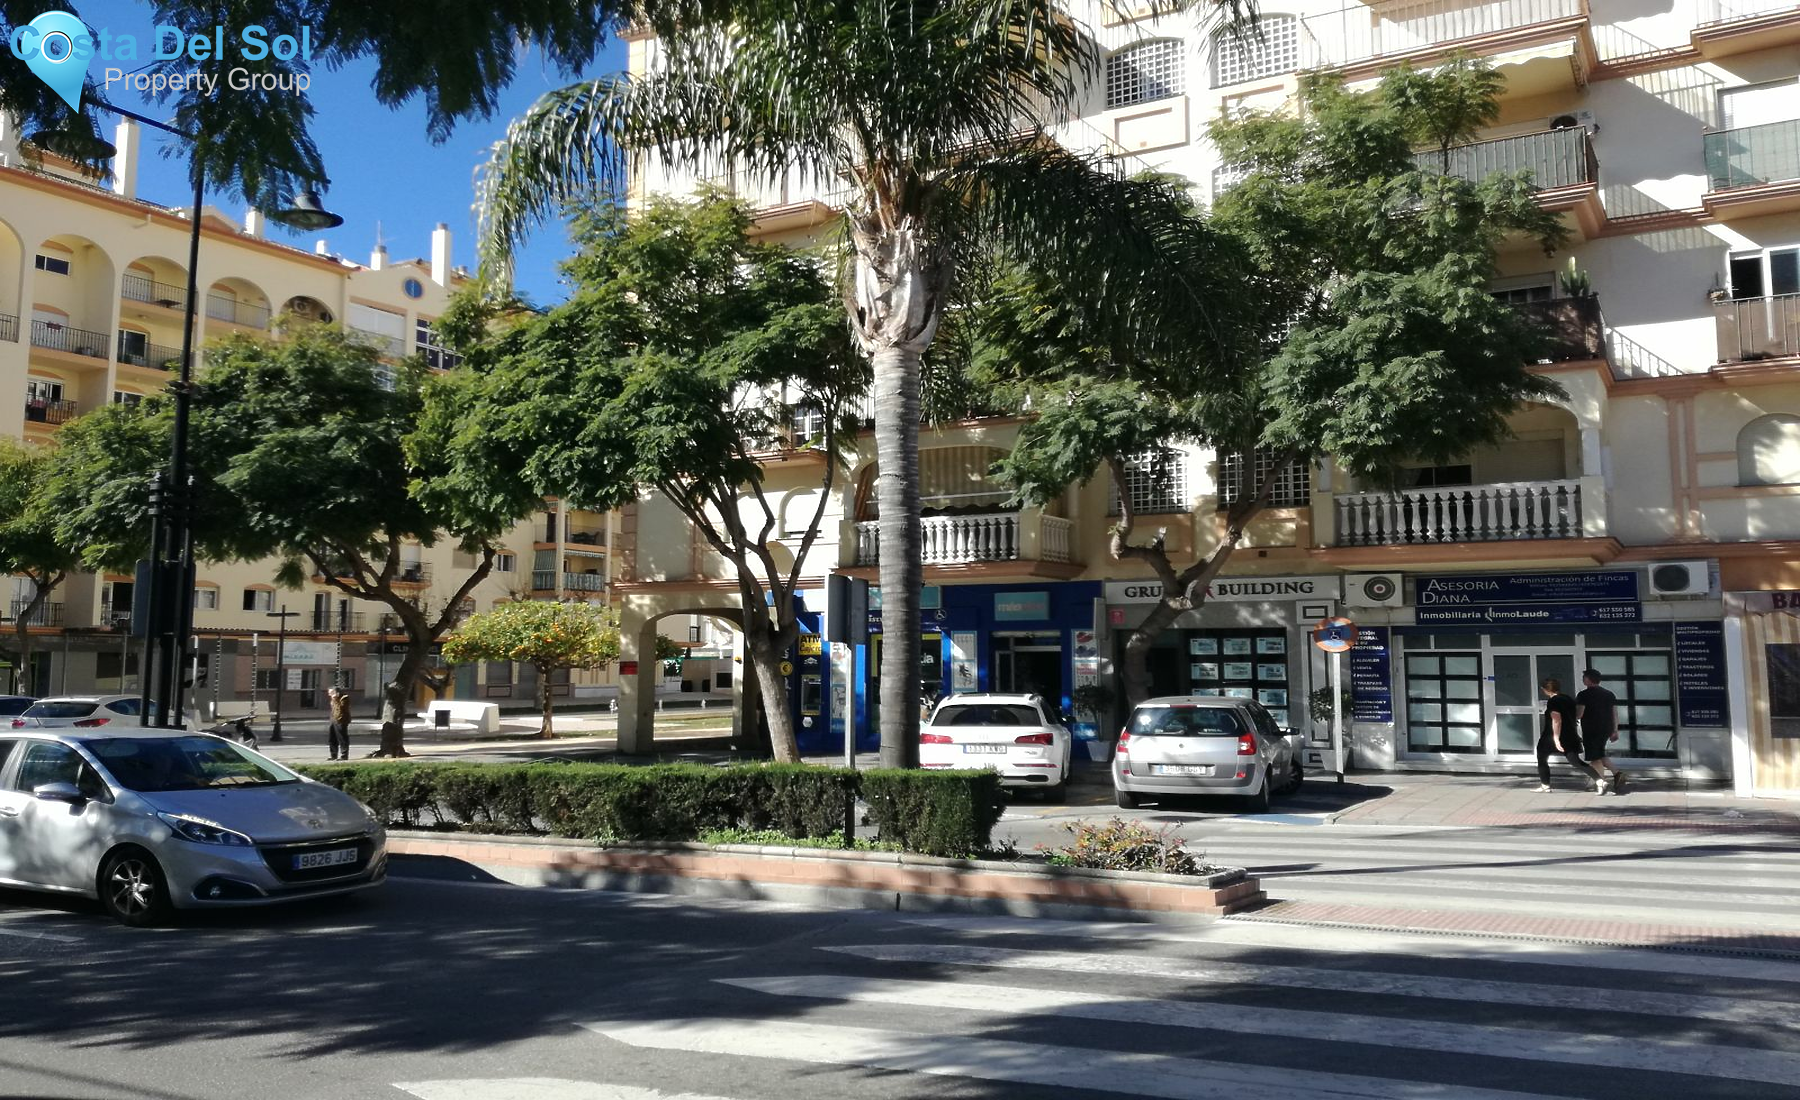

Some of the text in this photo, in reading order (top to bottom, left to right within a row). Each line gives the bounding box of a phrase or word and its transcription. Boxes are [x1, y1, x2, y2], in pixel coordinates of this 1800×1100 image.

[1427, 579, 1500, 591] ASESORIA
[1509, 575, 1581, 584] Administración
[1598, 574, 1629, 582] Fincas
[1124, 581, 1314, 598] GRU BUILDING
[1422, 591, 1470, 604] DIANA
[1420, 611, 1481, 620] Inmobiliaria
[800, 634, 821, 643] ATM
[301, 850, 356, 867] 9826 JJS
